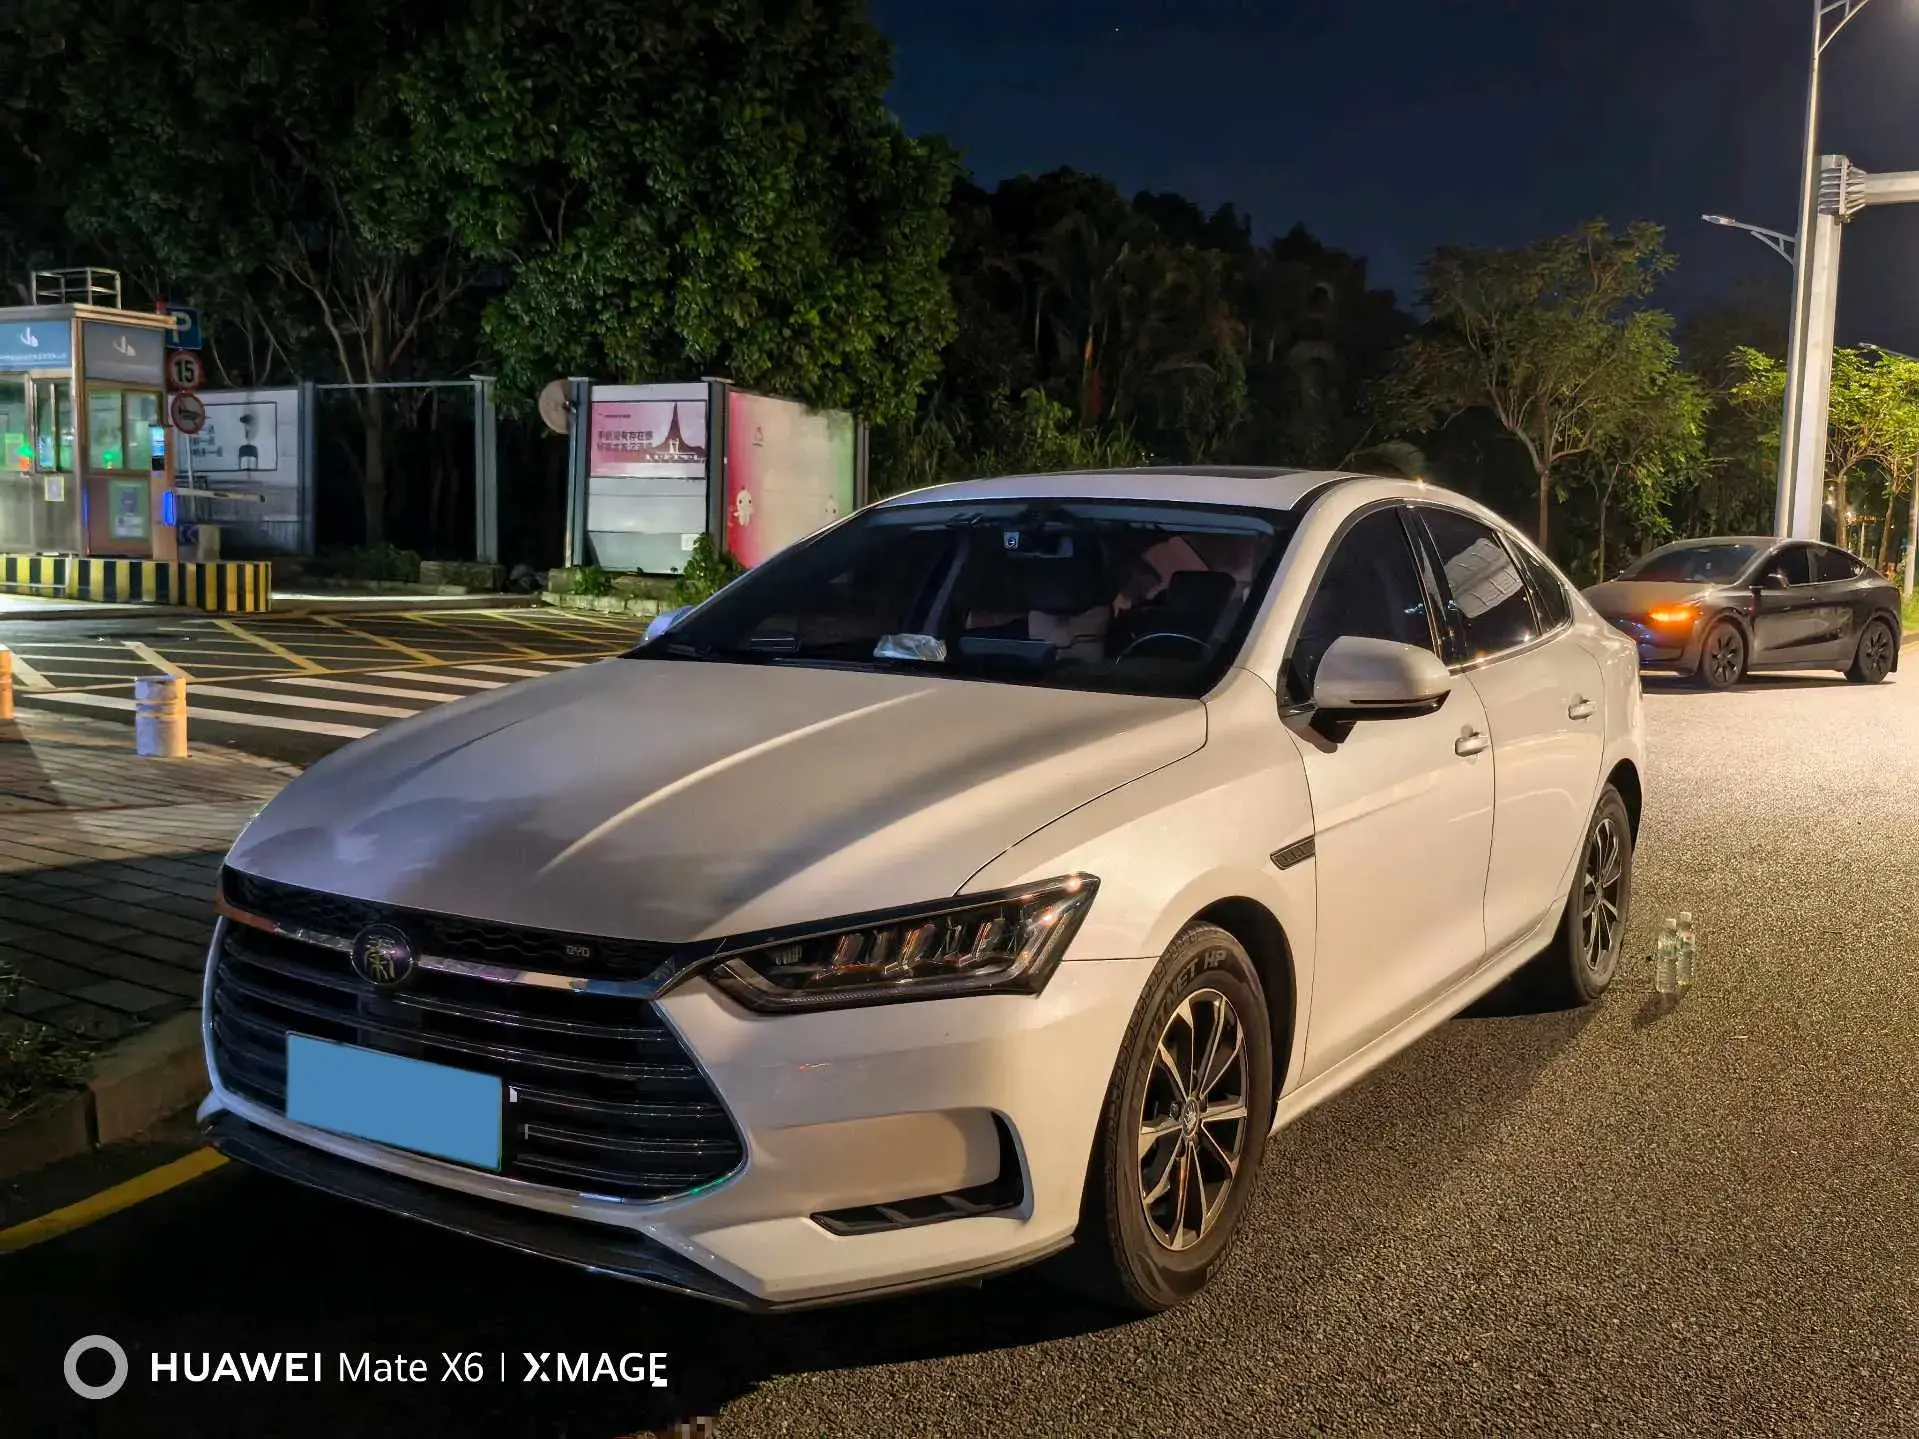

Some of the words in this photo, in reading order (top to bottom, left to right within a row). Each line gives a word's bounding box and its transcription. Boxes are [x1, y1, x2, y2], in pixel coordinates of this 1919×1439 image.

[171, 311, 192, 343] P
[174, 360, 194, 383] 15
[1203, 950, 1227, 970] HP
